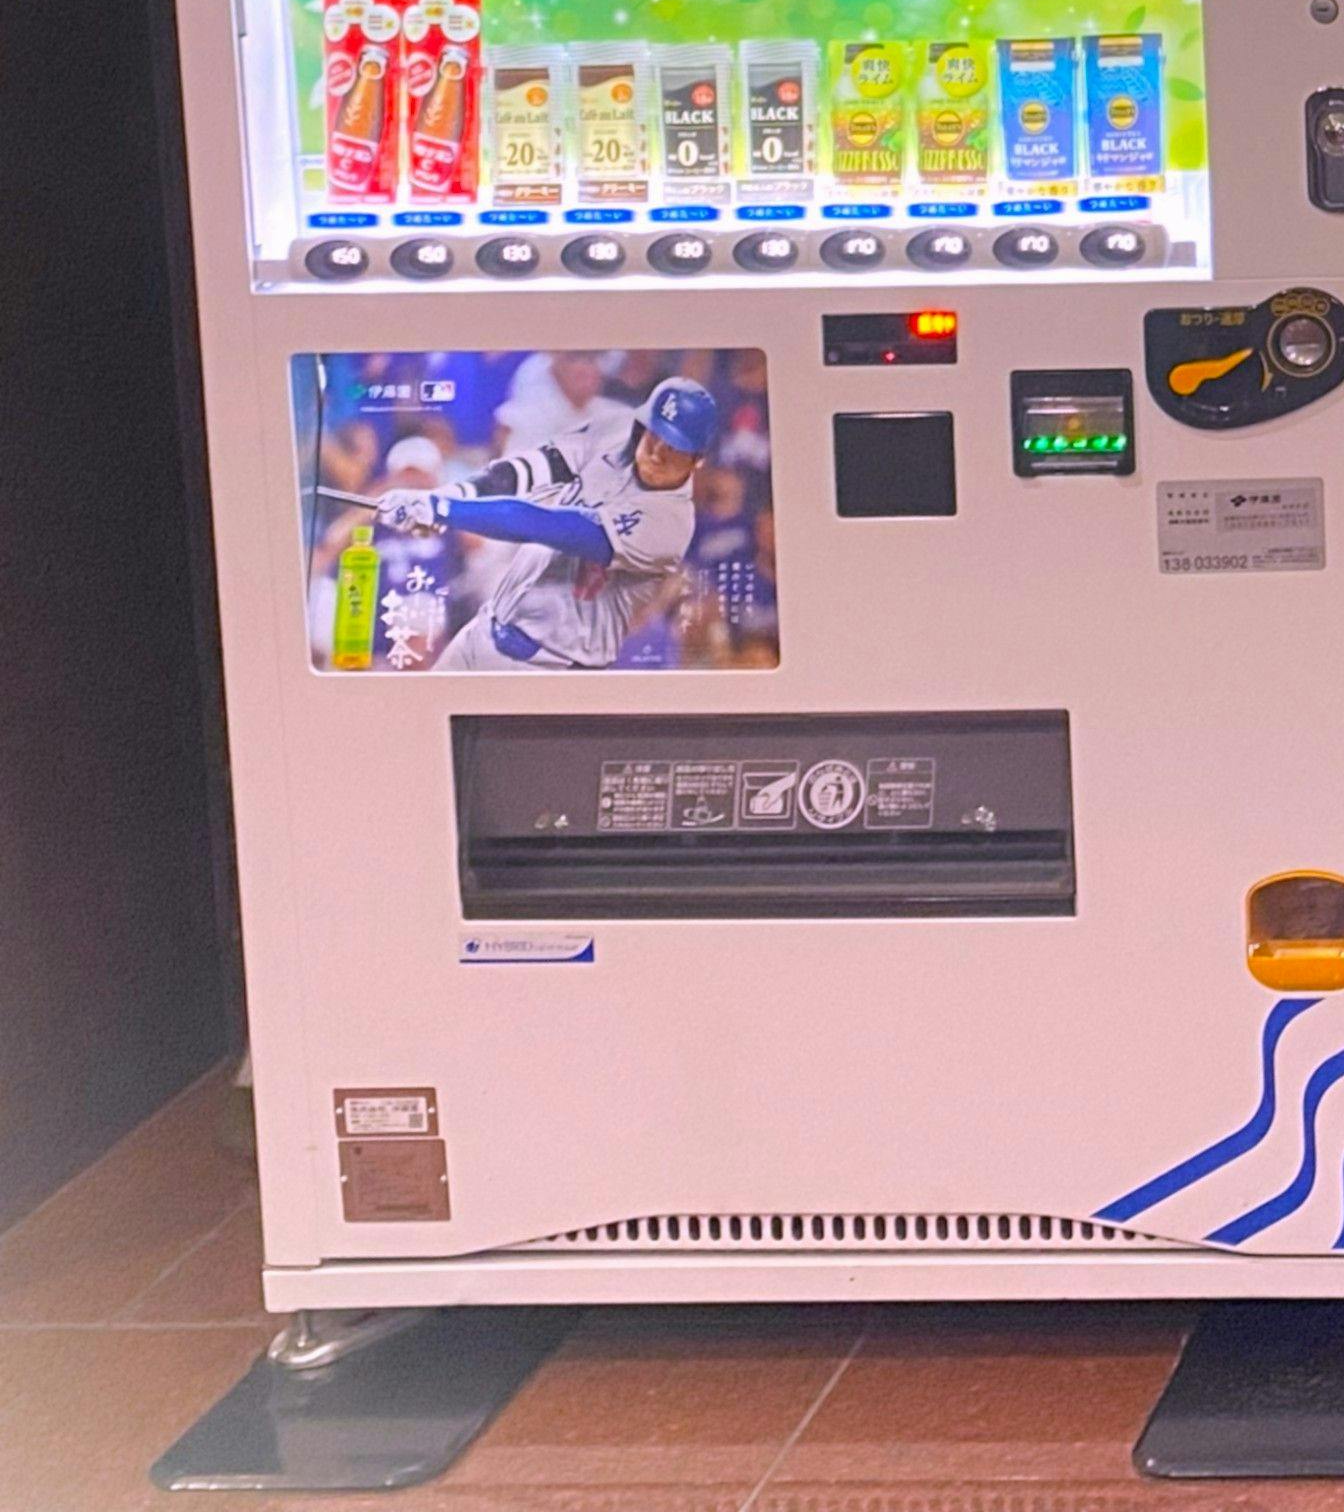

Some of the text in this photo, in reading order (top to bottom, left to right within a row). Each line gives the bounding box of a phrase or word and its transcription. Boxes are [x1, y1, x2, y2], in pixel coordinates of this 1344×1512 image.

[505, 143, 535, 167] 20
[591, 140, 622, 163] 20
[676, 139, 699, 168] 0
[761, 136, 784, 164] 0
[1014, 143, 1060, 156] BLACK
[1101, 139, 1146, 153] BLACK
[1163, 555, 1248, 572] 138 033902
